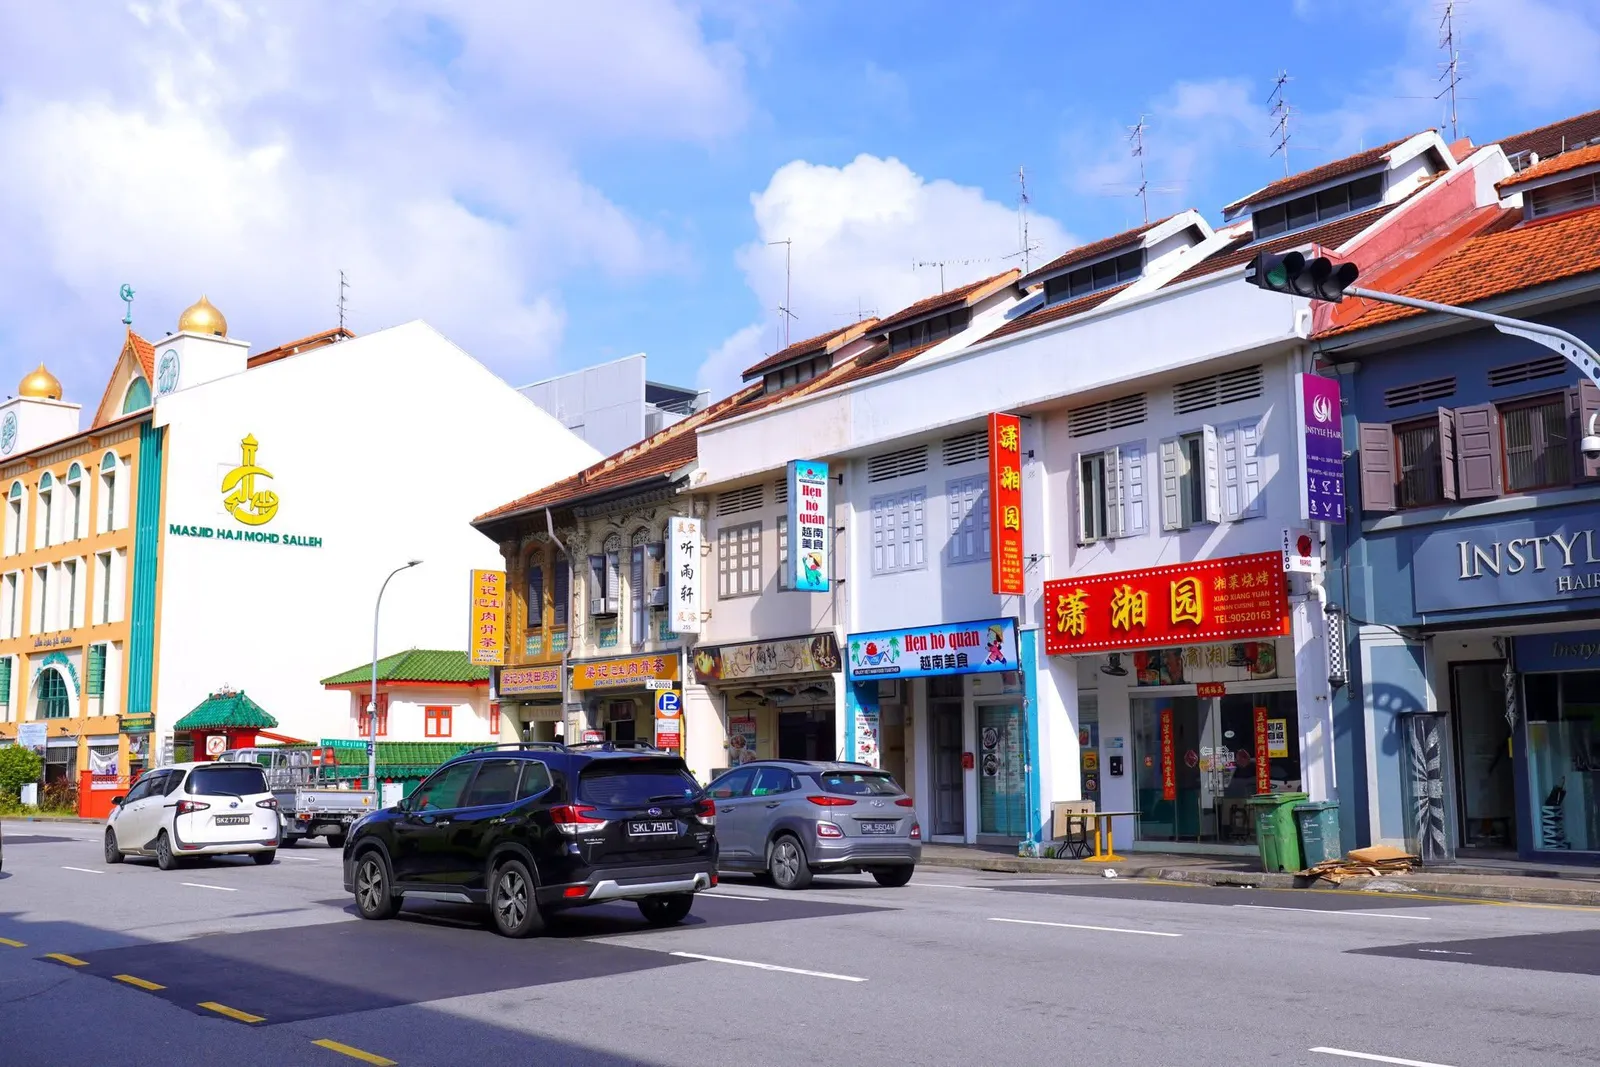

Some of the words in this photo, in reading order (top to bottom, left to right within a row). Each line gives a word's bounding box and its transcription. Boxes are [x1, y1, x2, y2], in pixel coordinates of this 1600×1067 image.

[169, 524, 213, 538] MASJID
[217, 529, 242, 541] HAJI
[244, 531, 279, 544] MOHD
[282, 534, 322, 548] SALLEH
[802, 527, 823, 538] 越南
[680, 541, 694, 604] 听雨轩
[1213, 570, 1269, 591] 湘菜烧烤
[1213, 594, 1229, 602] XIAO
[1230, 592, 1251, 601] XIANG
[1252, 590, 1270, 598] YUAN
[1056, 576, 1203, 637] 潇湘园
[1214, 610, 1271, 624] TEL:90520163
[905, 634, 927, 655] Hẹn
[949, 628, 980, 650] quán
[919, 652, 969, 671] 越南美食
[341, 740, 367, 748] Geylang
[632, 823, 651, 833] SKL
